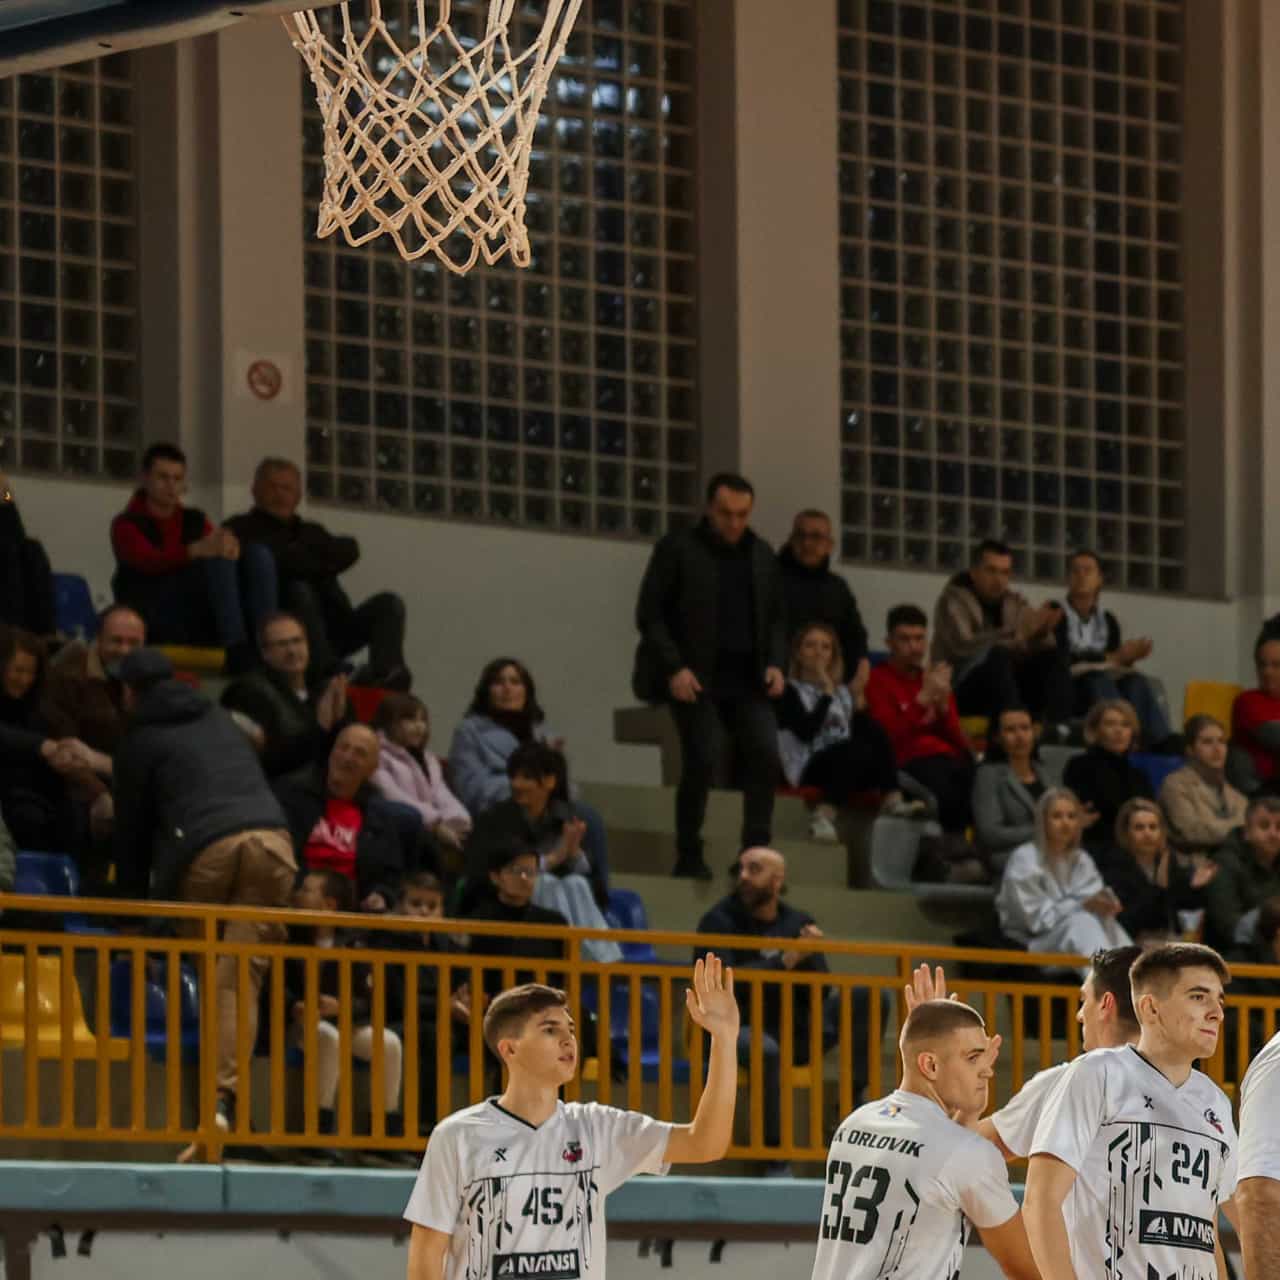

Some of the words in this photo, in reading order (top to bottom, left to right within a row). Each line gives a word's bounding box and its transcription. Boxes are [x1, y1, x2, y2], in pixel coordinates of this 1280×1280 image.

[848, 1130, 925, 1158] ORLOVIK
[1171, 1141, 1210, 1189] 24
[521, 1187, 564, 1225] 45
[822, 1160, 891, 1245] 33
